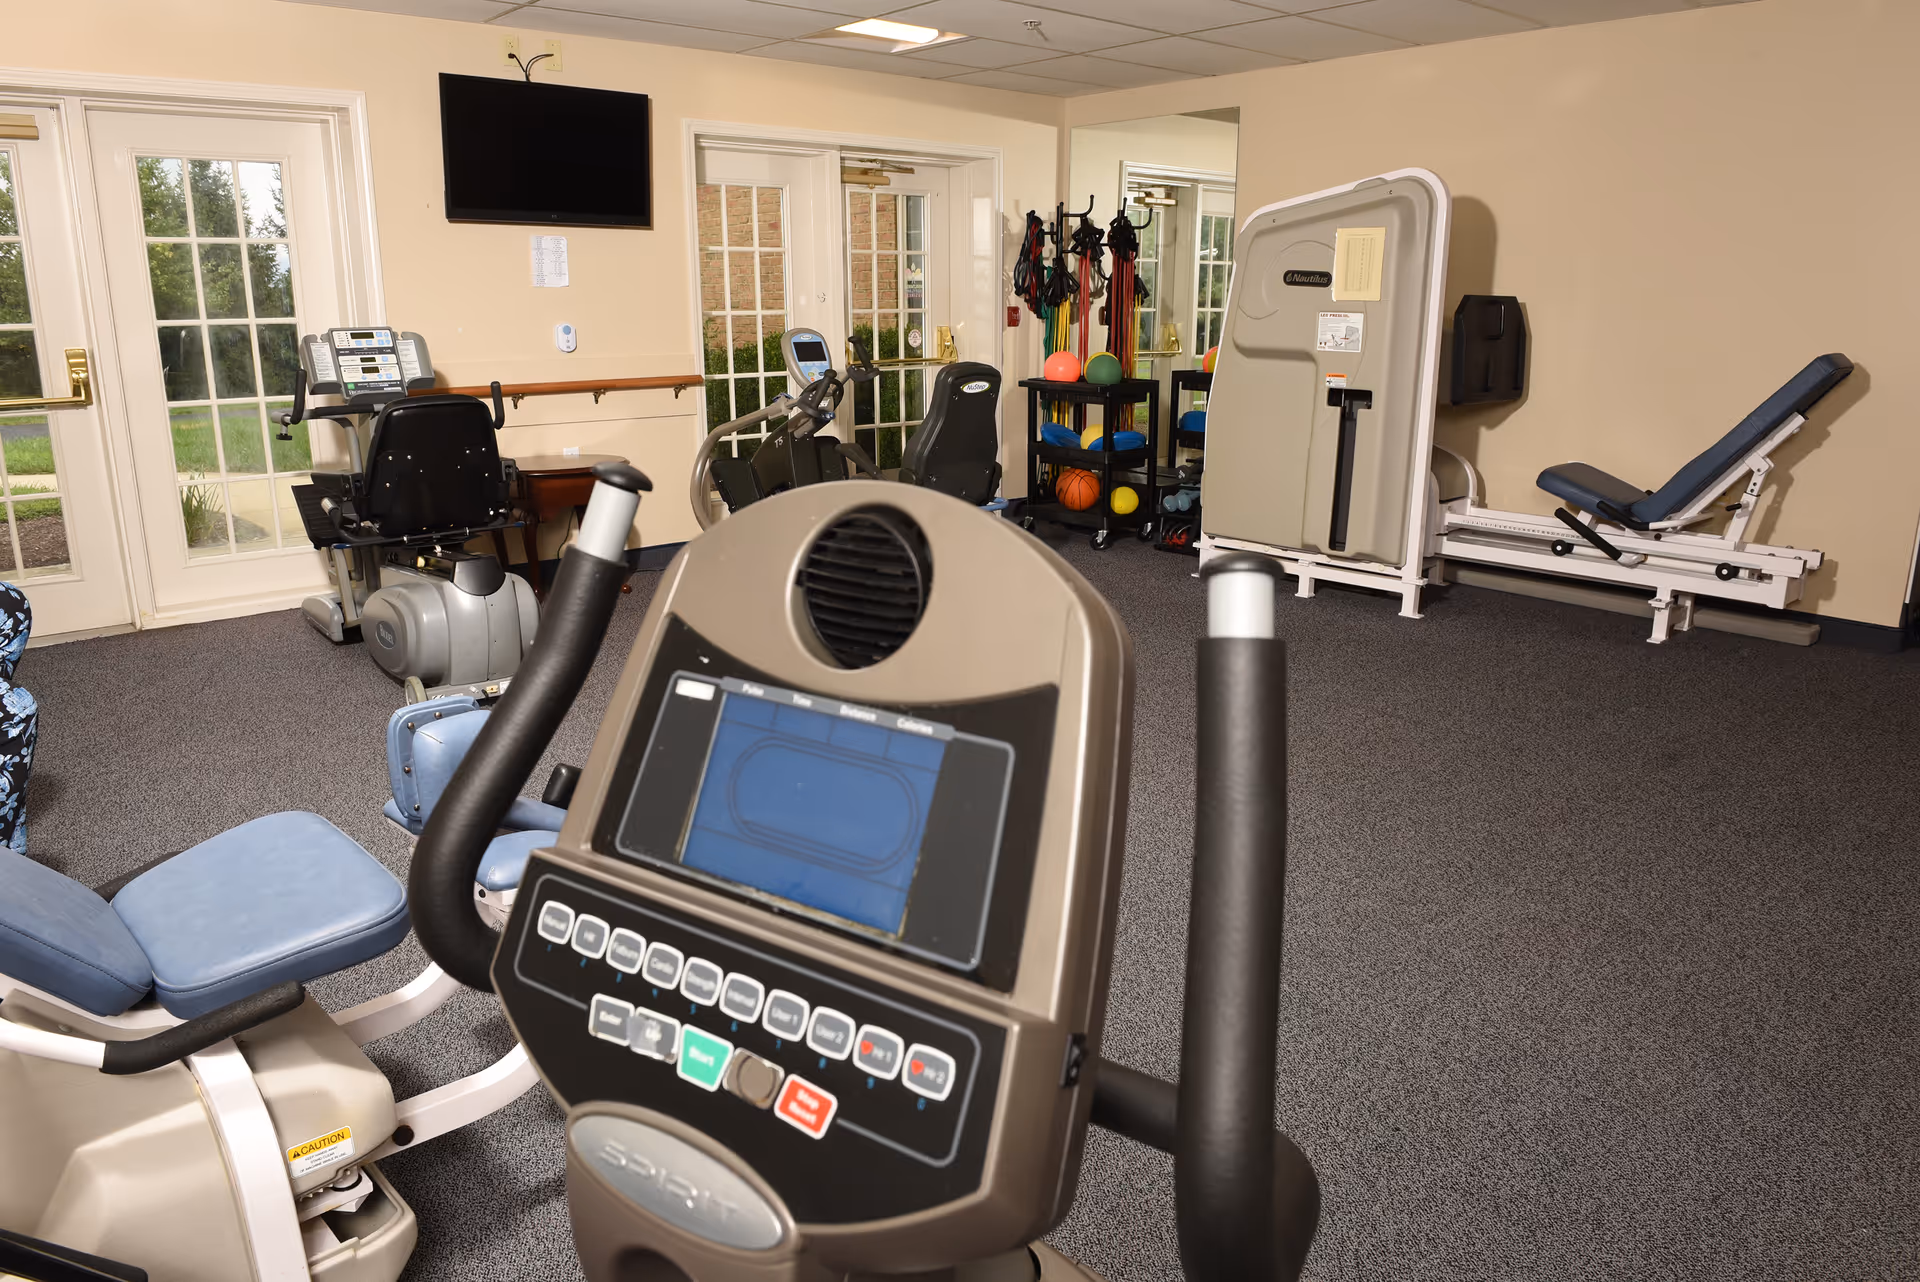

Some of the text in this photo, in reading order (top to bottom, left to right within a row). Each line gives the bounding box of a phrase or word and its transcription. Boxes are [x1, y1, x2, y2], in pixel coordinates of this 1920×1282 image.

[1292, 273, 1329, 284] Nautilus
[967, 383, 986, 391] NuStep
[775, 436, 784, 448] T5
[742, 683, 764, 696] Pulse
[793, 694, 812, 707] Time
[840, 705, 877, 722] Distance
[897, 718, 933, 735] Calories
[771, 1007, 793, 1023] User
[815, 1024, 845, 1045] User 2
[688, 1046, 715, 1067] Start
[935, 1071, 946, 1085] 2
[796, 1088, 819, 1110] Stop
[788, 1101, 817, 1126] Reset
[301, 1132, 345, 1155] CAUTION
[599, 1139, 740, 1223] SPIRIT
